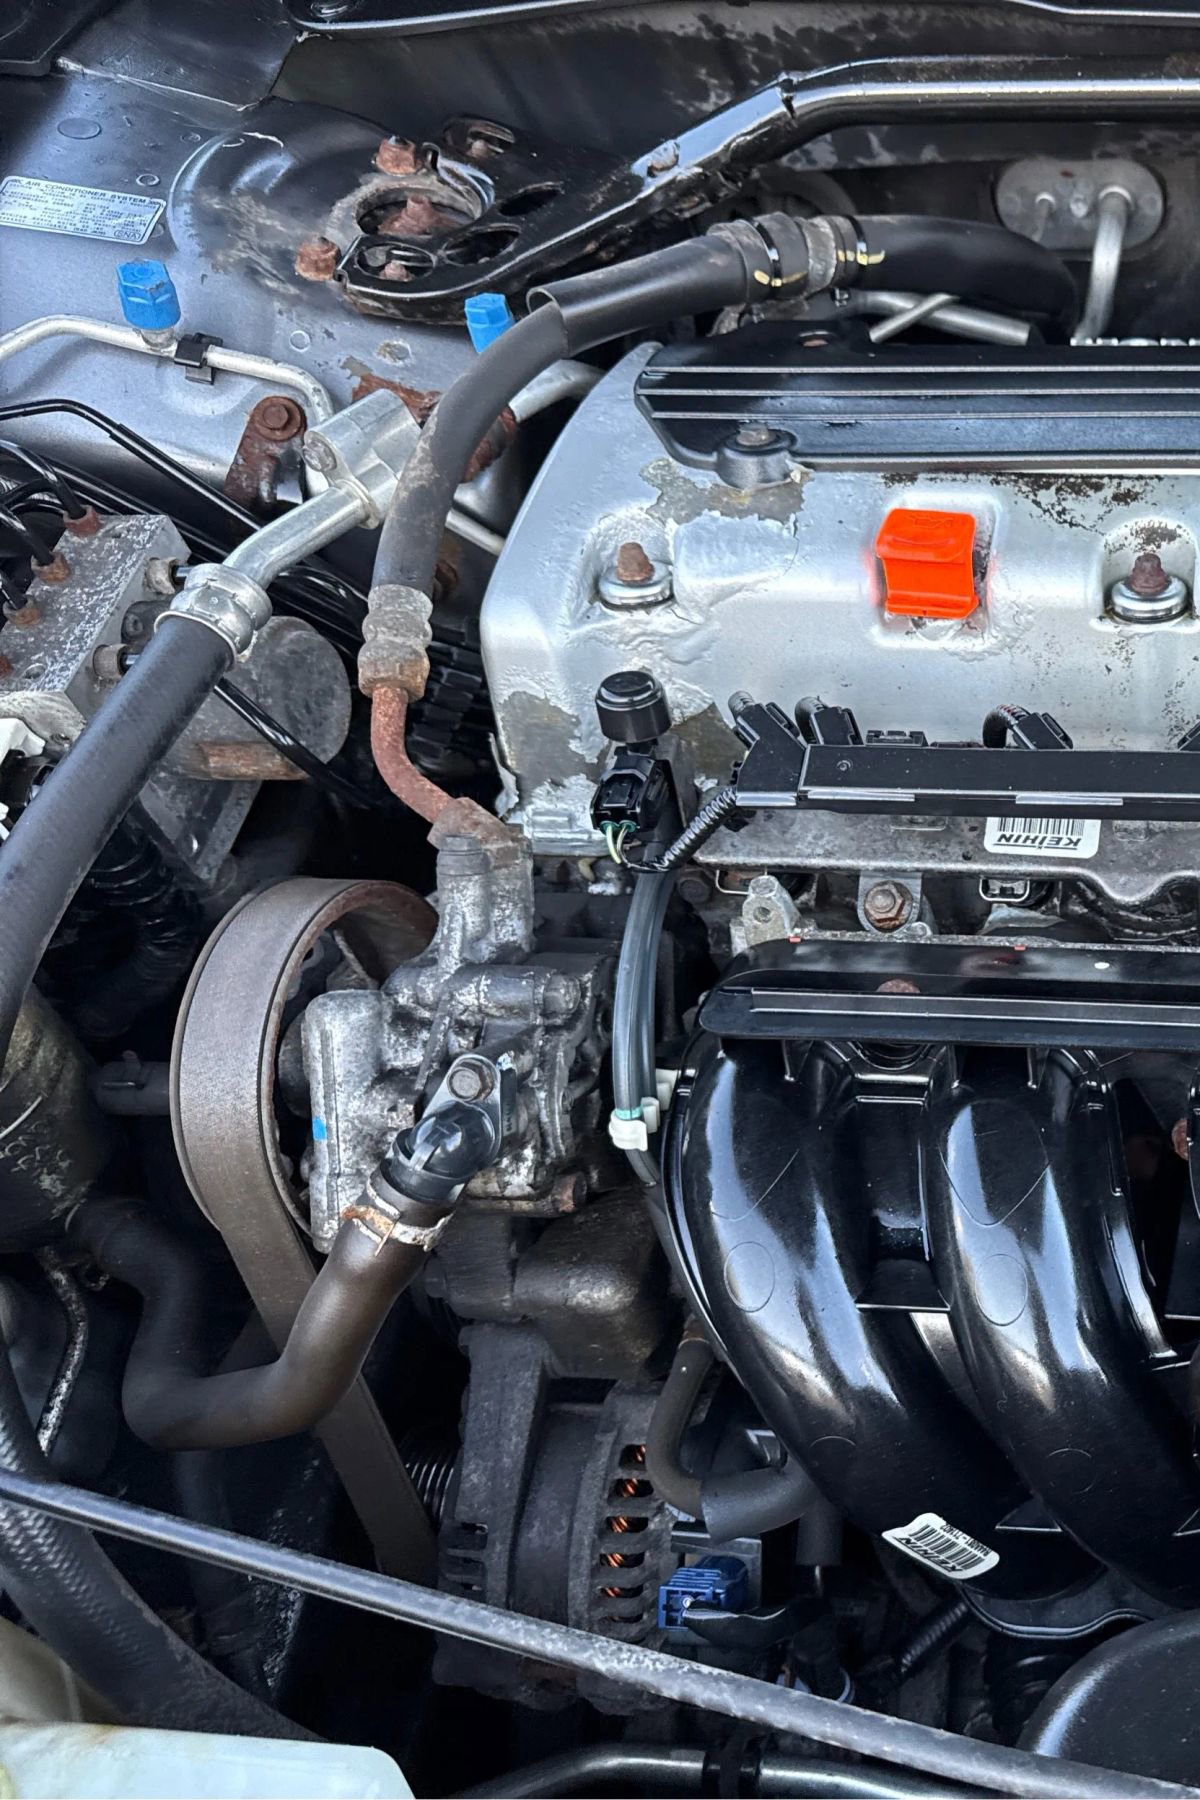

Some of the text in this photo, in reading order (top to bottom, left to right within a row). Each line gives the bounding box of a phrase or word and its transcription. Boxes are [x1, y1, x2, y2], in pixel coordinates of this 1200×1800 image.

[45, 183, 107, 198] CONDITIONER
[110, 195, 147, 204] SYSTEM
[997, 833, 1082, 848] KEIHIN
